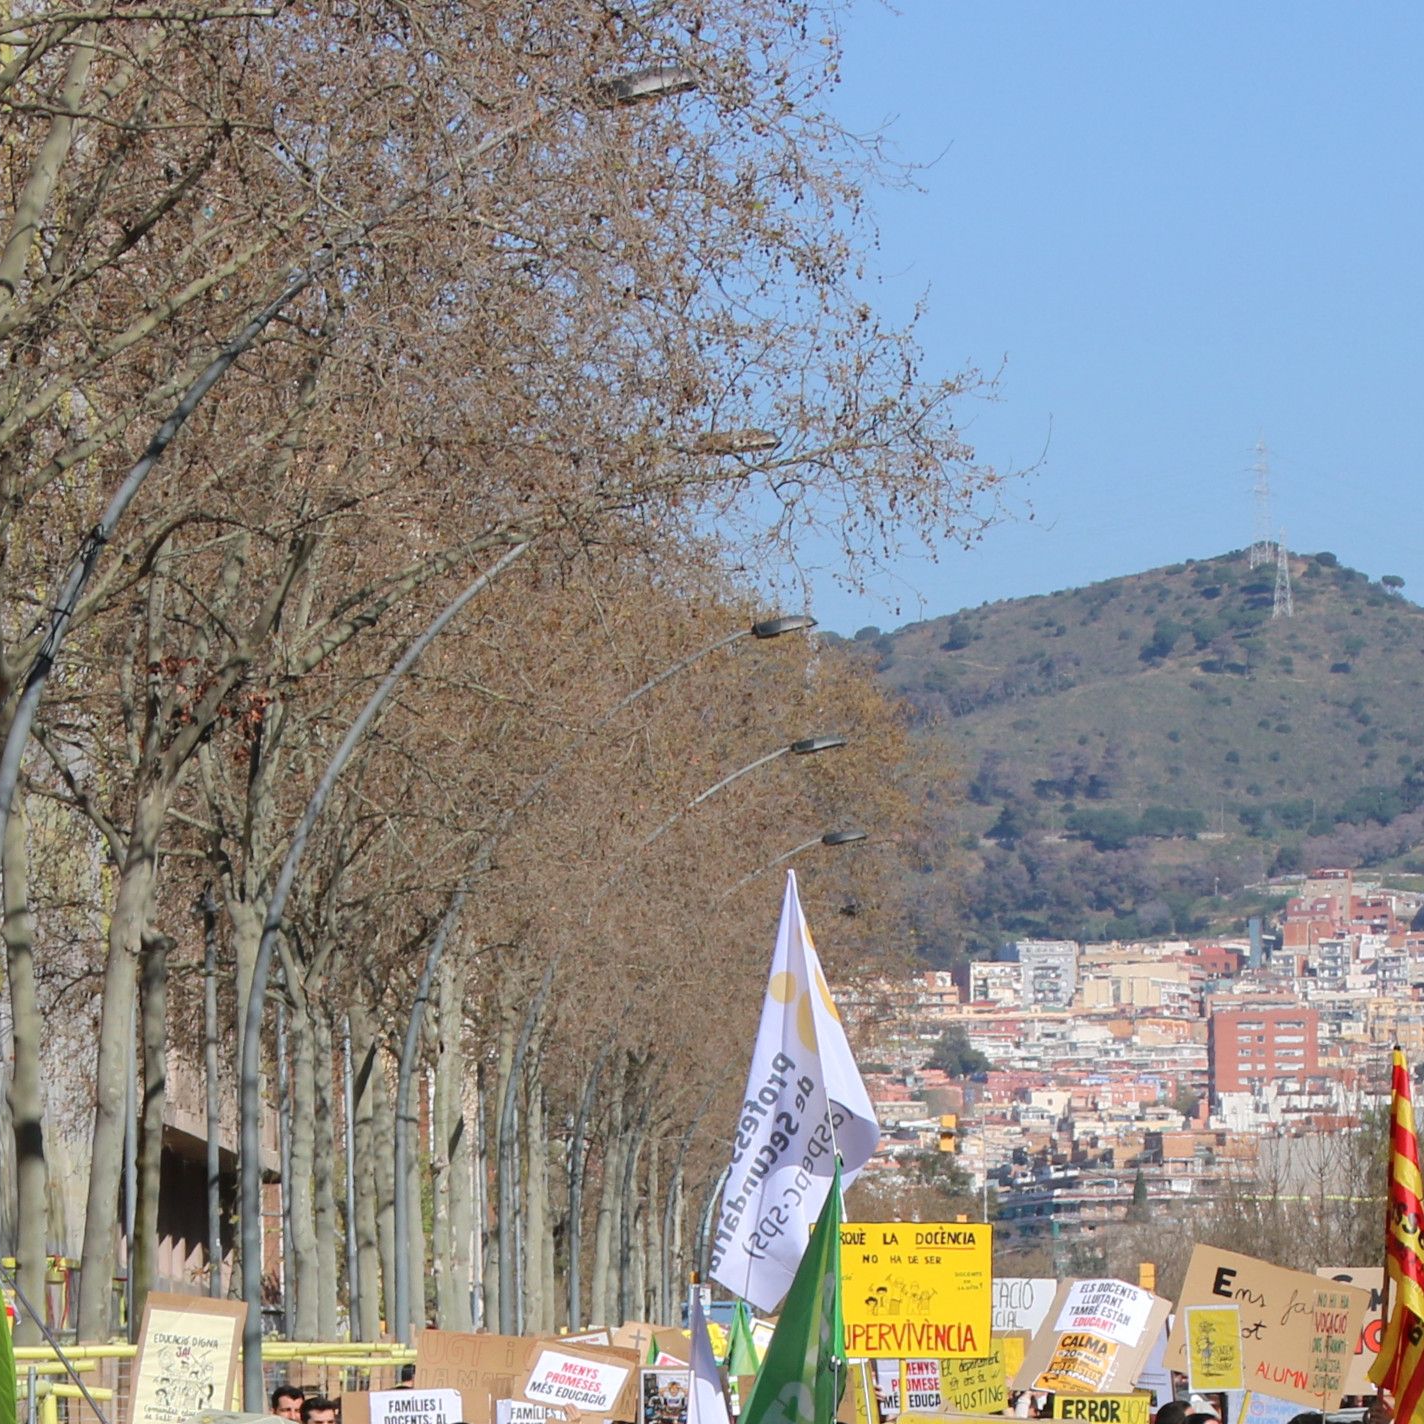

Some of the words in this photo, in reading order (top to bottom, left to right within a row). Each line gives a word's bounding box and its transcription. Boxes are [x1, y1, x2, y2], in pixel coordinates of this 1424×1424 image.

[882, 1232, 899, 1246] LA
[915, 1226, 976, 1246] DOCÈNCIA
[862, 1254, 879, 1264] NO
[889, 1255, 902, 1264] HA
[907, 1255, 919, 1264] DE
[924, 1255, 942, 1265] SER
[1080, 1282, 1096, 1294] ELS
[1097, 1282, 1138, 1302] DOCENTS
[1212, 1267, 1266, 1308] Ens
[1069, 1304, 1100, 1317] TAMBÉ
[1100, 1306, 1131, 1326] ESTAN
[844, 1319, 977, 1352] UPERVIVÈNCIA
[1072, 1317, 1117, 1334] EDUCANT!
[191, 1337, 219, 1349] DIGNA
[422, 1332, 490, 1367] UGT
[1061, 1335, 1108, 1355] CALMA
[561, 1362, 600, 1379] MENYS
[529, 1381, 553, 1396] MÉS
[388, 1396, 436, 1413] FAMÍLIES
[510, 1405, 557, 1420] FAMÍLIES
[1062, 1399, 1122, 1424] ERROR
